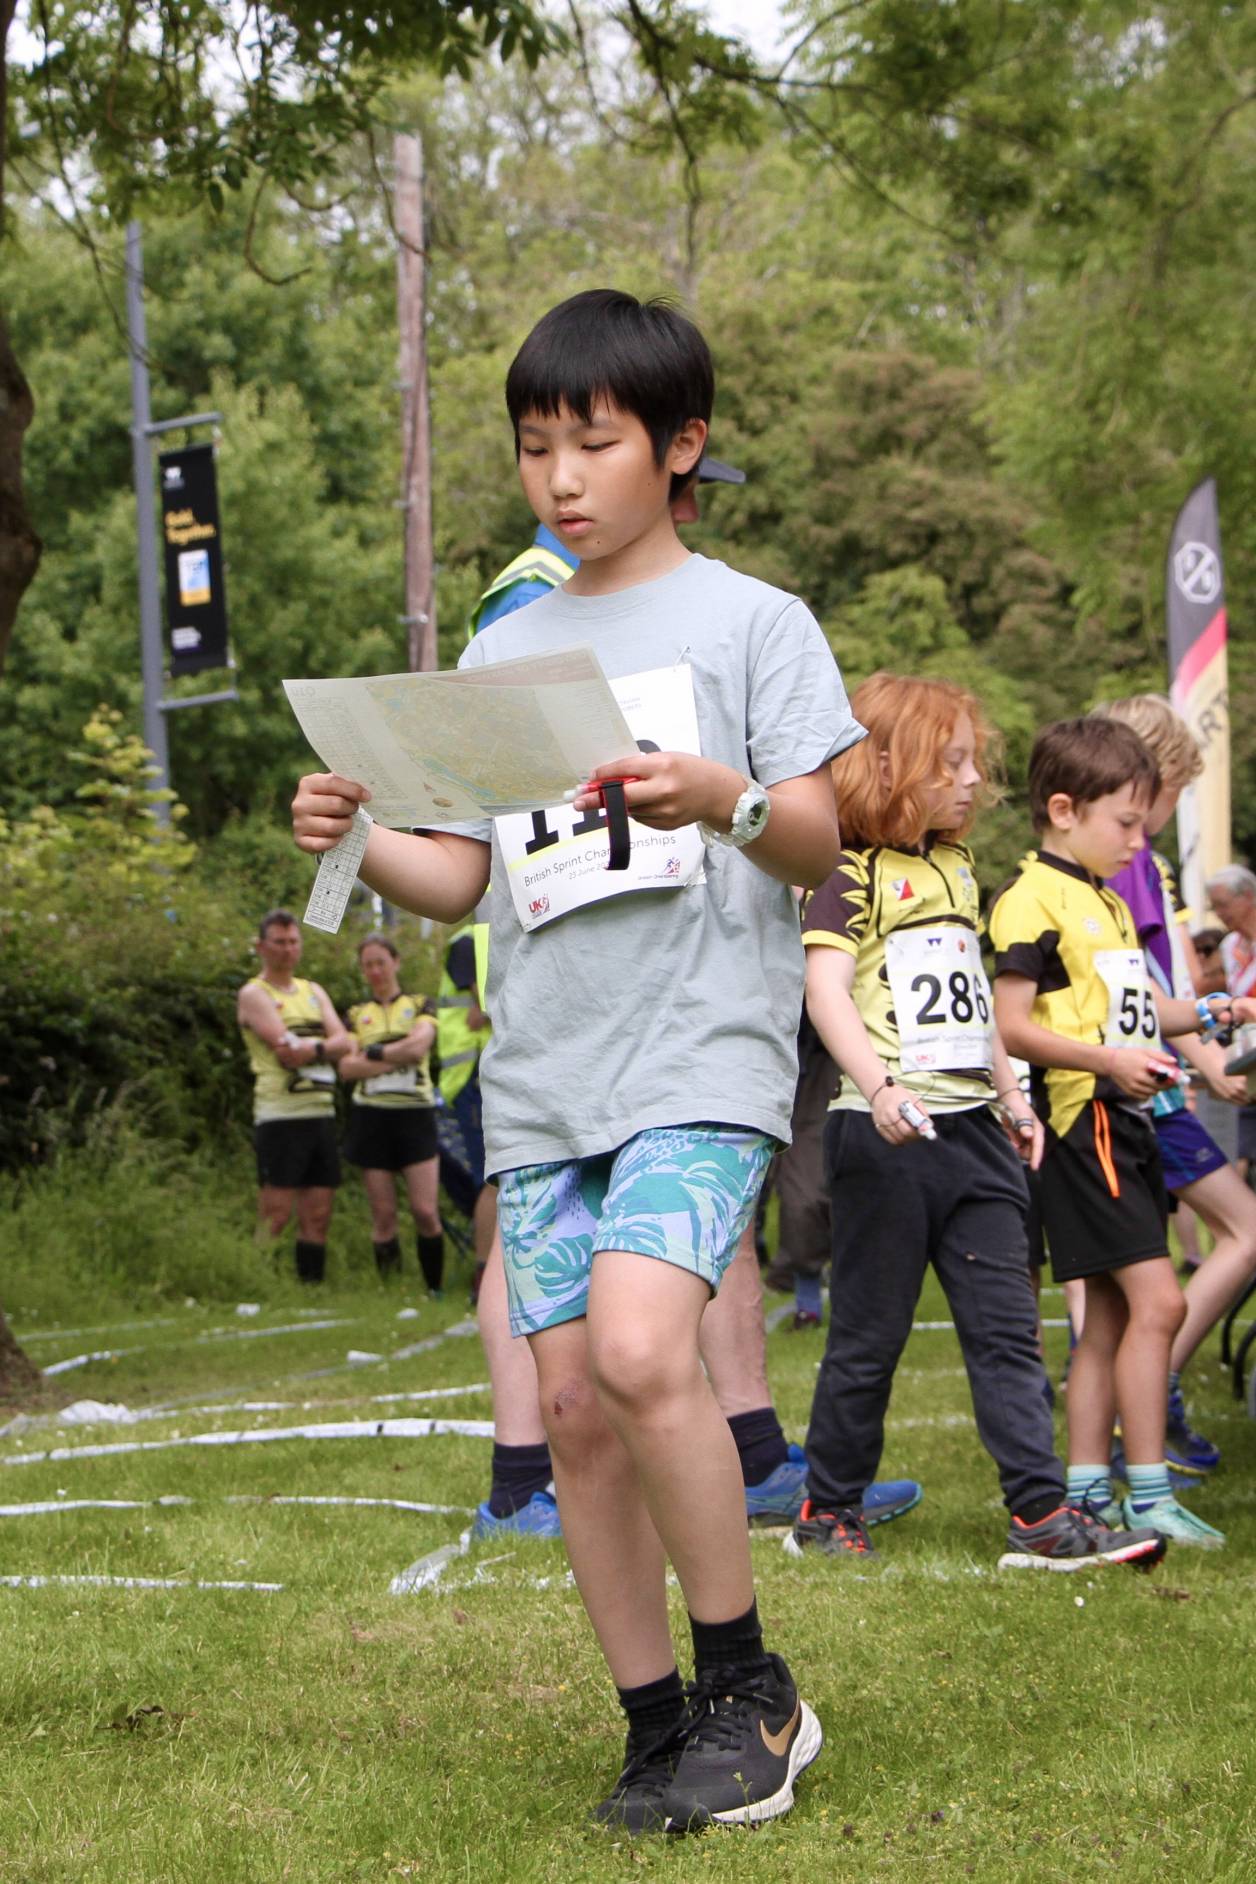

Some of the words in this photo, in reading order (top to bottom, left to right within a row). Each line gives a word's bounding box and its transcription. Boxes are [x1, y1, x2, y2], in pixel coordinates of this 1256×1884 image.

[524, 867, 551, 887] British
[553, 855, 582, 874] Sprint
[585, 836, 676, 862] Chaonships
[911, 971, 988, 1025] 286
[1118, 987, 1156, 1039] 55
